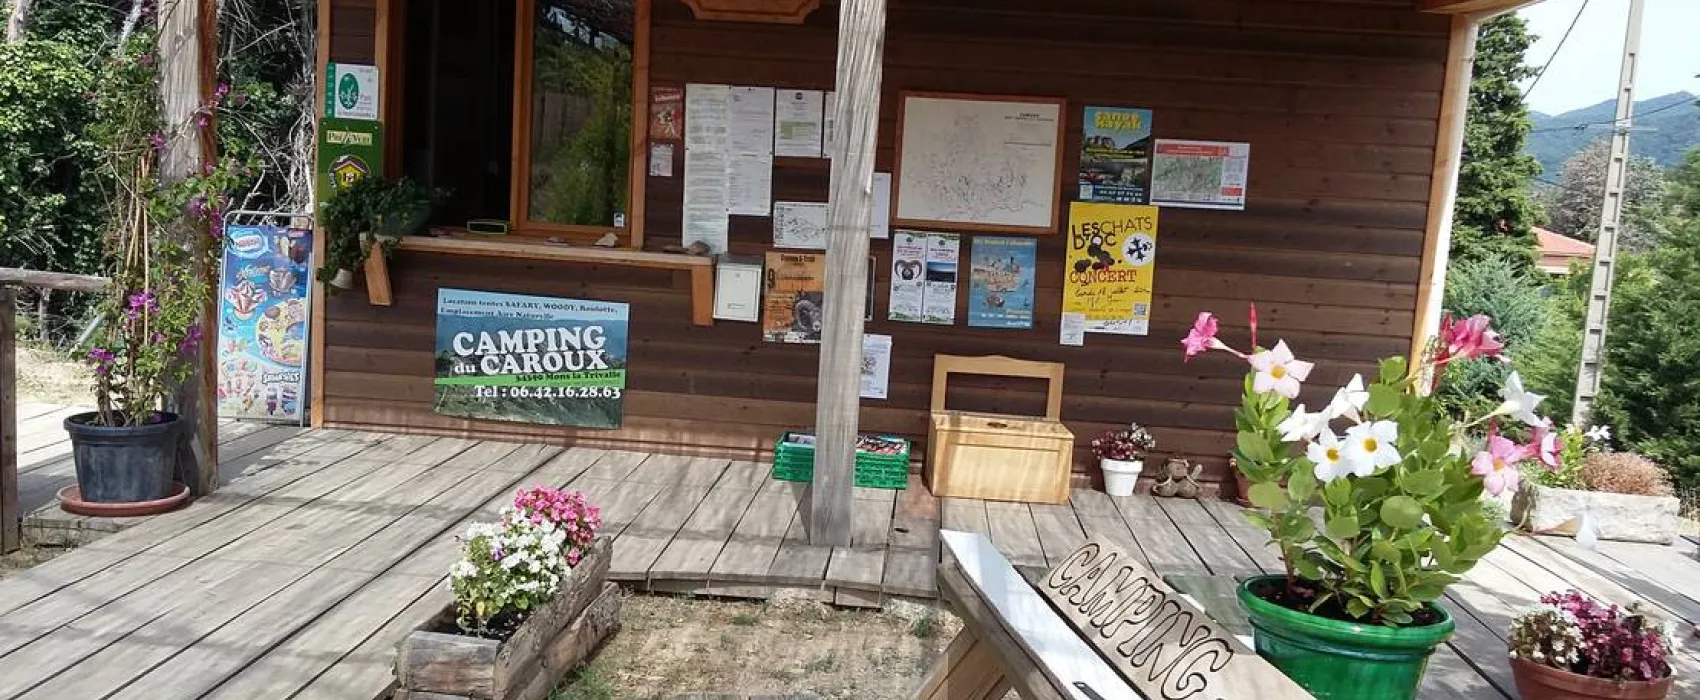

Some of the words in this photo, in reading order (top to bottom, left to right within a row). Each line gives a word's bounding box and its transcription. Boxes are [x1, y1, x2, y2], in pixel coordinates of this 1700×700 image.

[1069, 270, 1137, 284] CONCERT
[452, 326, 606, 356] CAMPING
[454, 363, 476, 374] du
[480, 349, 609, 375] CAROUX
[545, 373, 571, 381] Mons
[474, 385, 497, 398] Tel
[509, 385, 621, 399] 06.42.16.28.63
[1049, 542, 1234, 700] CAMPING
